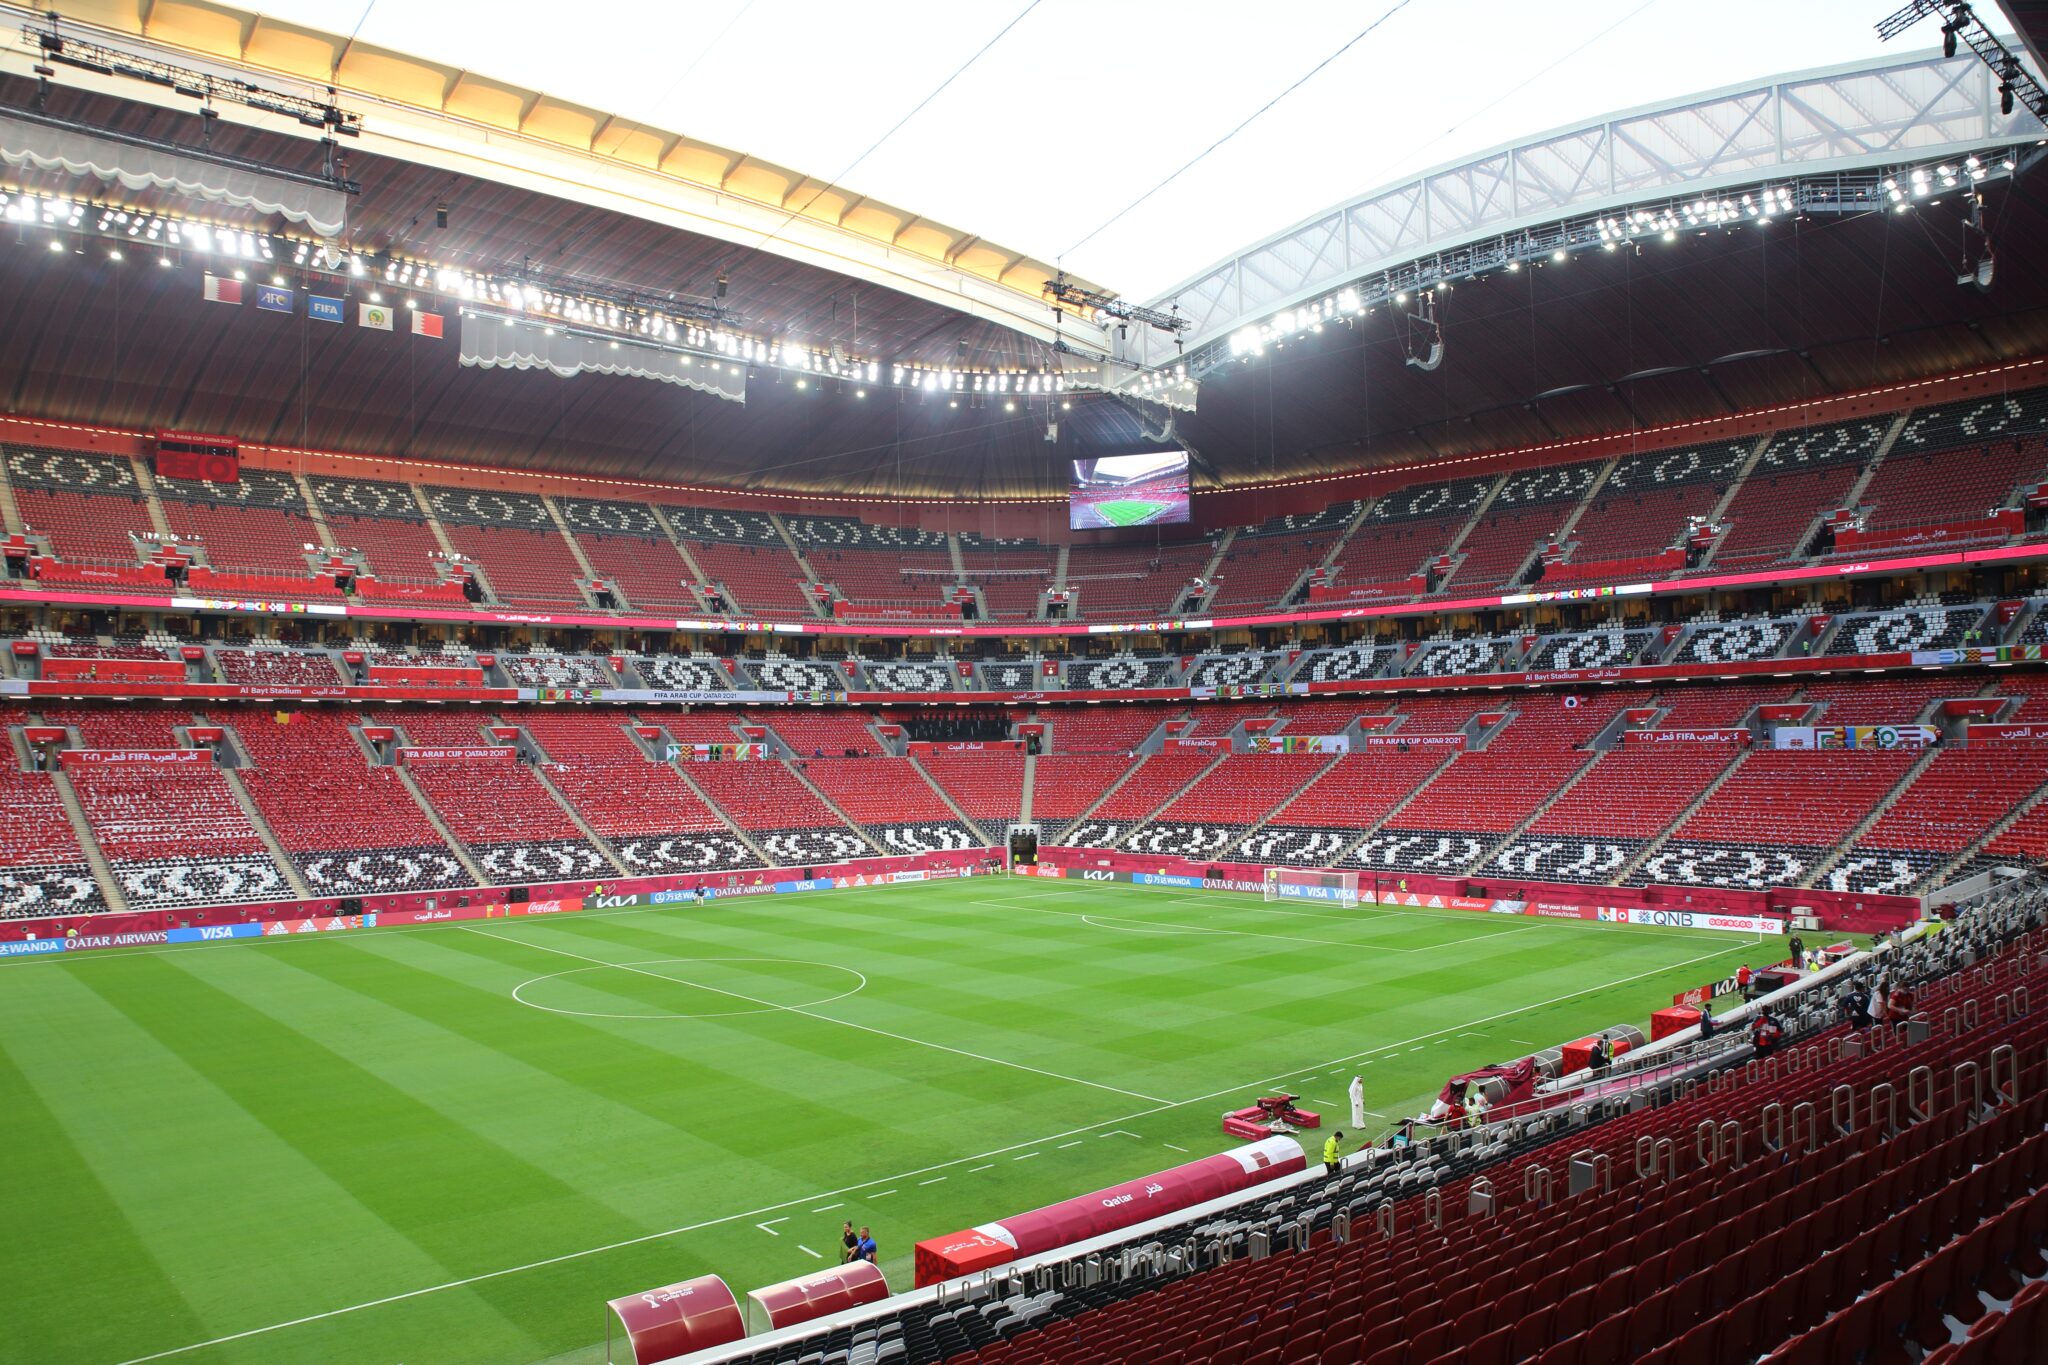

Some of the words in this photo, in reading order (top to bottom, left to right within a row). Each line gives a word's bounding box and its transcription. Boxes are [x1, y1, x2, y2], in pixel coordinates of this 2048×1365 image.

[314, 303, 338, 315] FIFA
[1655, 732, 1674, 742] قطر
[1697, 733, 1718, 742] العرب
[103, 752, 125, 763] قطر
[152, 753, 176, 763] العرب
[715, 887, 741, 897] QATAR
[744, 883, 776, 893] AIRWAYS
[796, 880, 816, 890] VISA
[1203, 878, 1233, 890] QATAR
[1236, 881, 1276, 893] AIRWAYS
[1280, 885, 1300, 895] VISA
[1307, 887, 1327, 897] VISA
[1334, 889, 1355, 900] VISA
[528, 900, 561, 913] Coca-Cola
[414, 913, 432, 921] البيت
[433, 910, 452, 919] استاد
[1653, 912, 1692, 927] QNB
[1709, 918, 1753, 928] ooredoo
[1760, 922, 1774, 930] 5G
[201, 927, 233, 939] VISA
[65, 936, 110, 949] QATAR
[113, 931, 168, 945] AIRWAYS
[1145, 1183, 1163, 1198] قطر
[1102, 1194, 1133, 1207] Qatar
